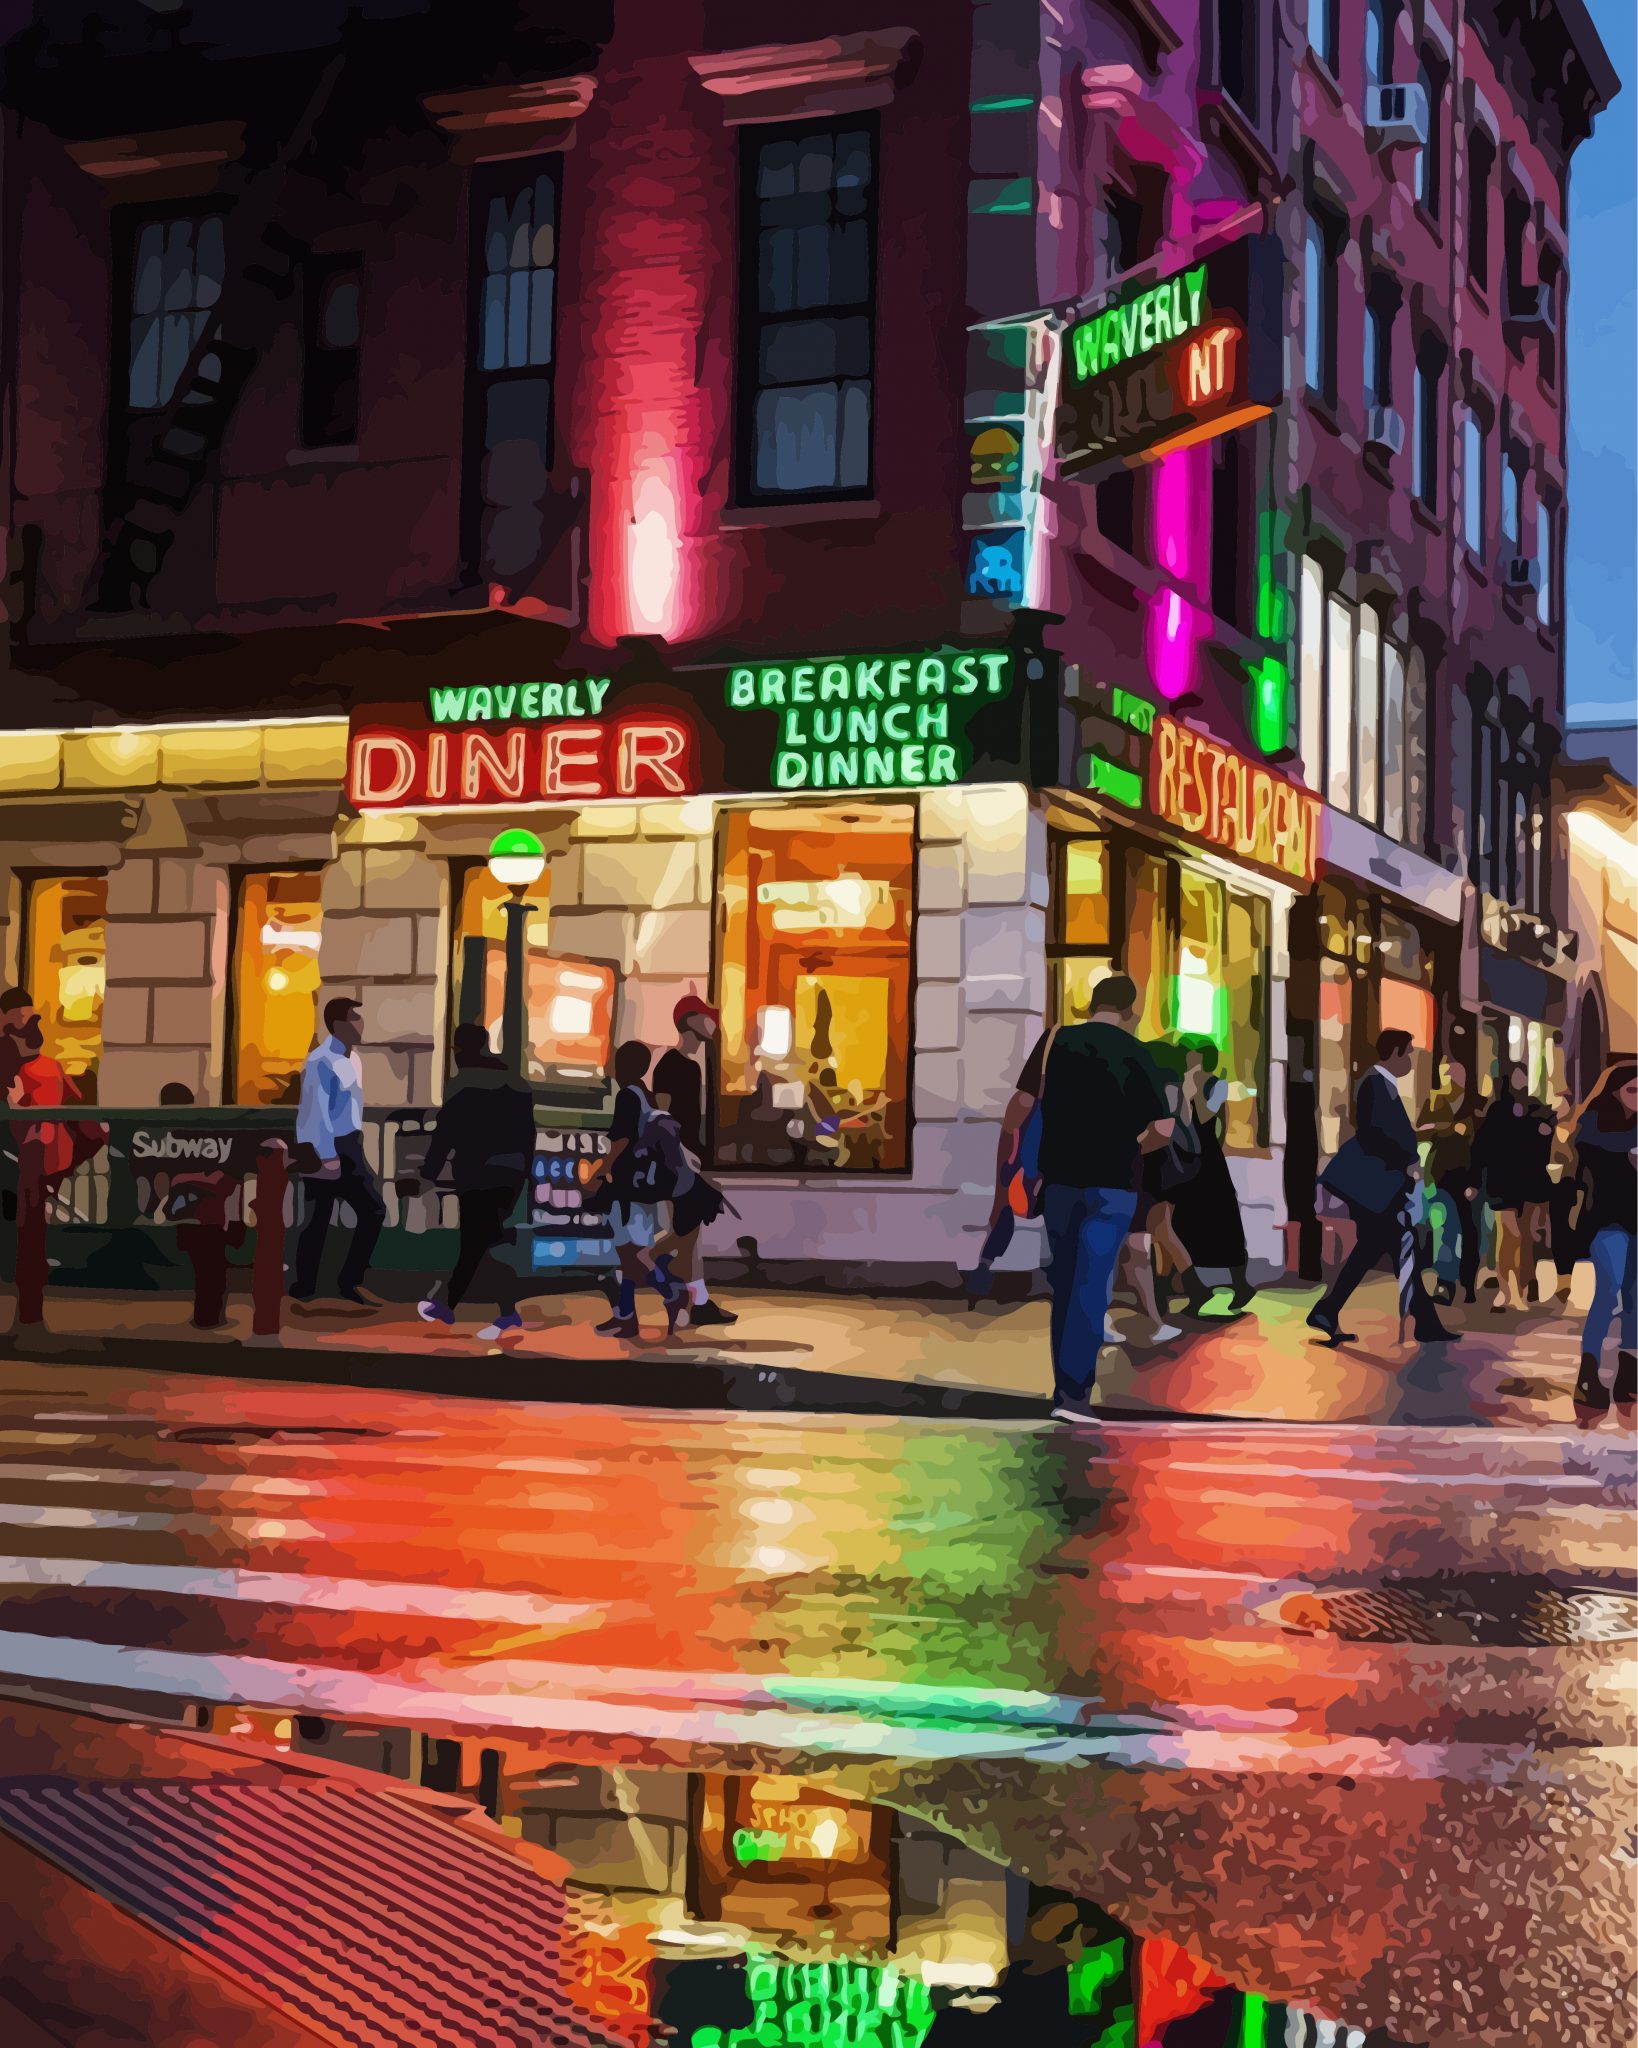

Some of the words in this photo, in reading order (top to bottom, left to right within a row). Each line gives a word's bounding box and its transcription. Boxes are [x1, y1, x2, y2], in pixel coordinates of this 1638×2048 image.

[1073, 264, 1208, 380] WAVERLY
[432, 678, 611, 722] WAVERLY
[730, 654, 1008, 706] BREAKFAST
[785, 702, 948, 744] LUNCH
[352, 727, 686, 801] DINER
[777, 744, 959, 787] DINNER
[1159, 717, 1322, 880] RESTAURANT
[132, 1131, 233, 1163] Subway
